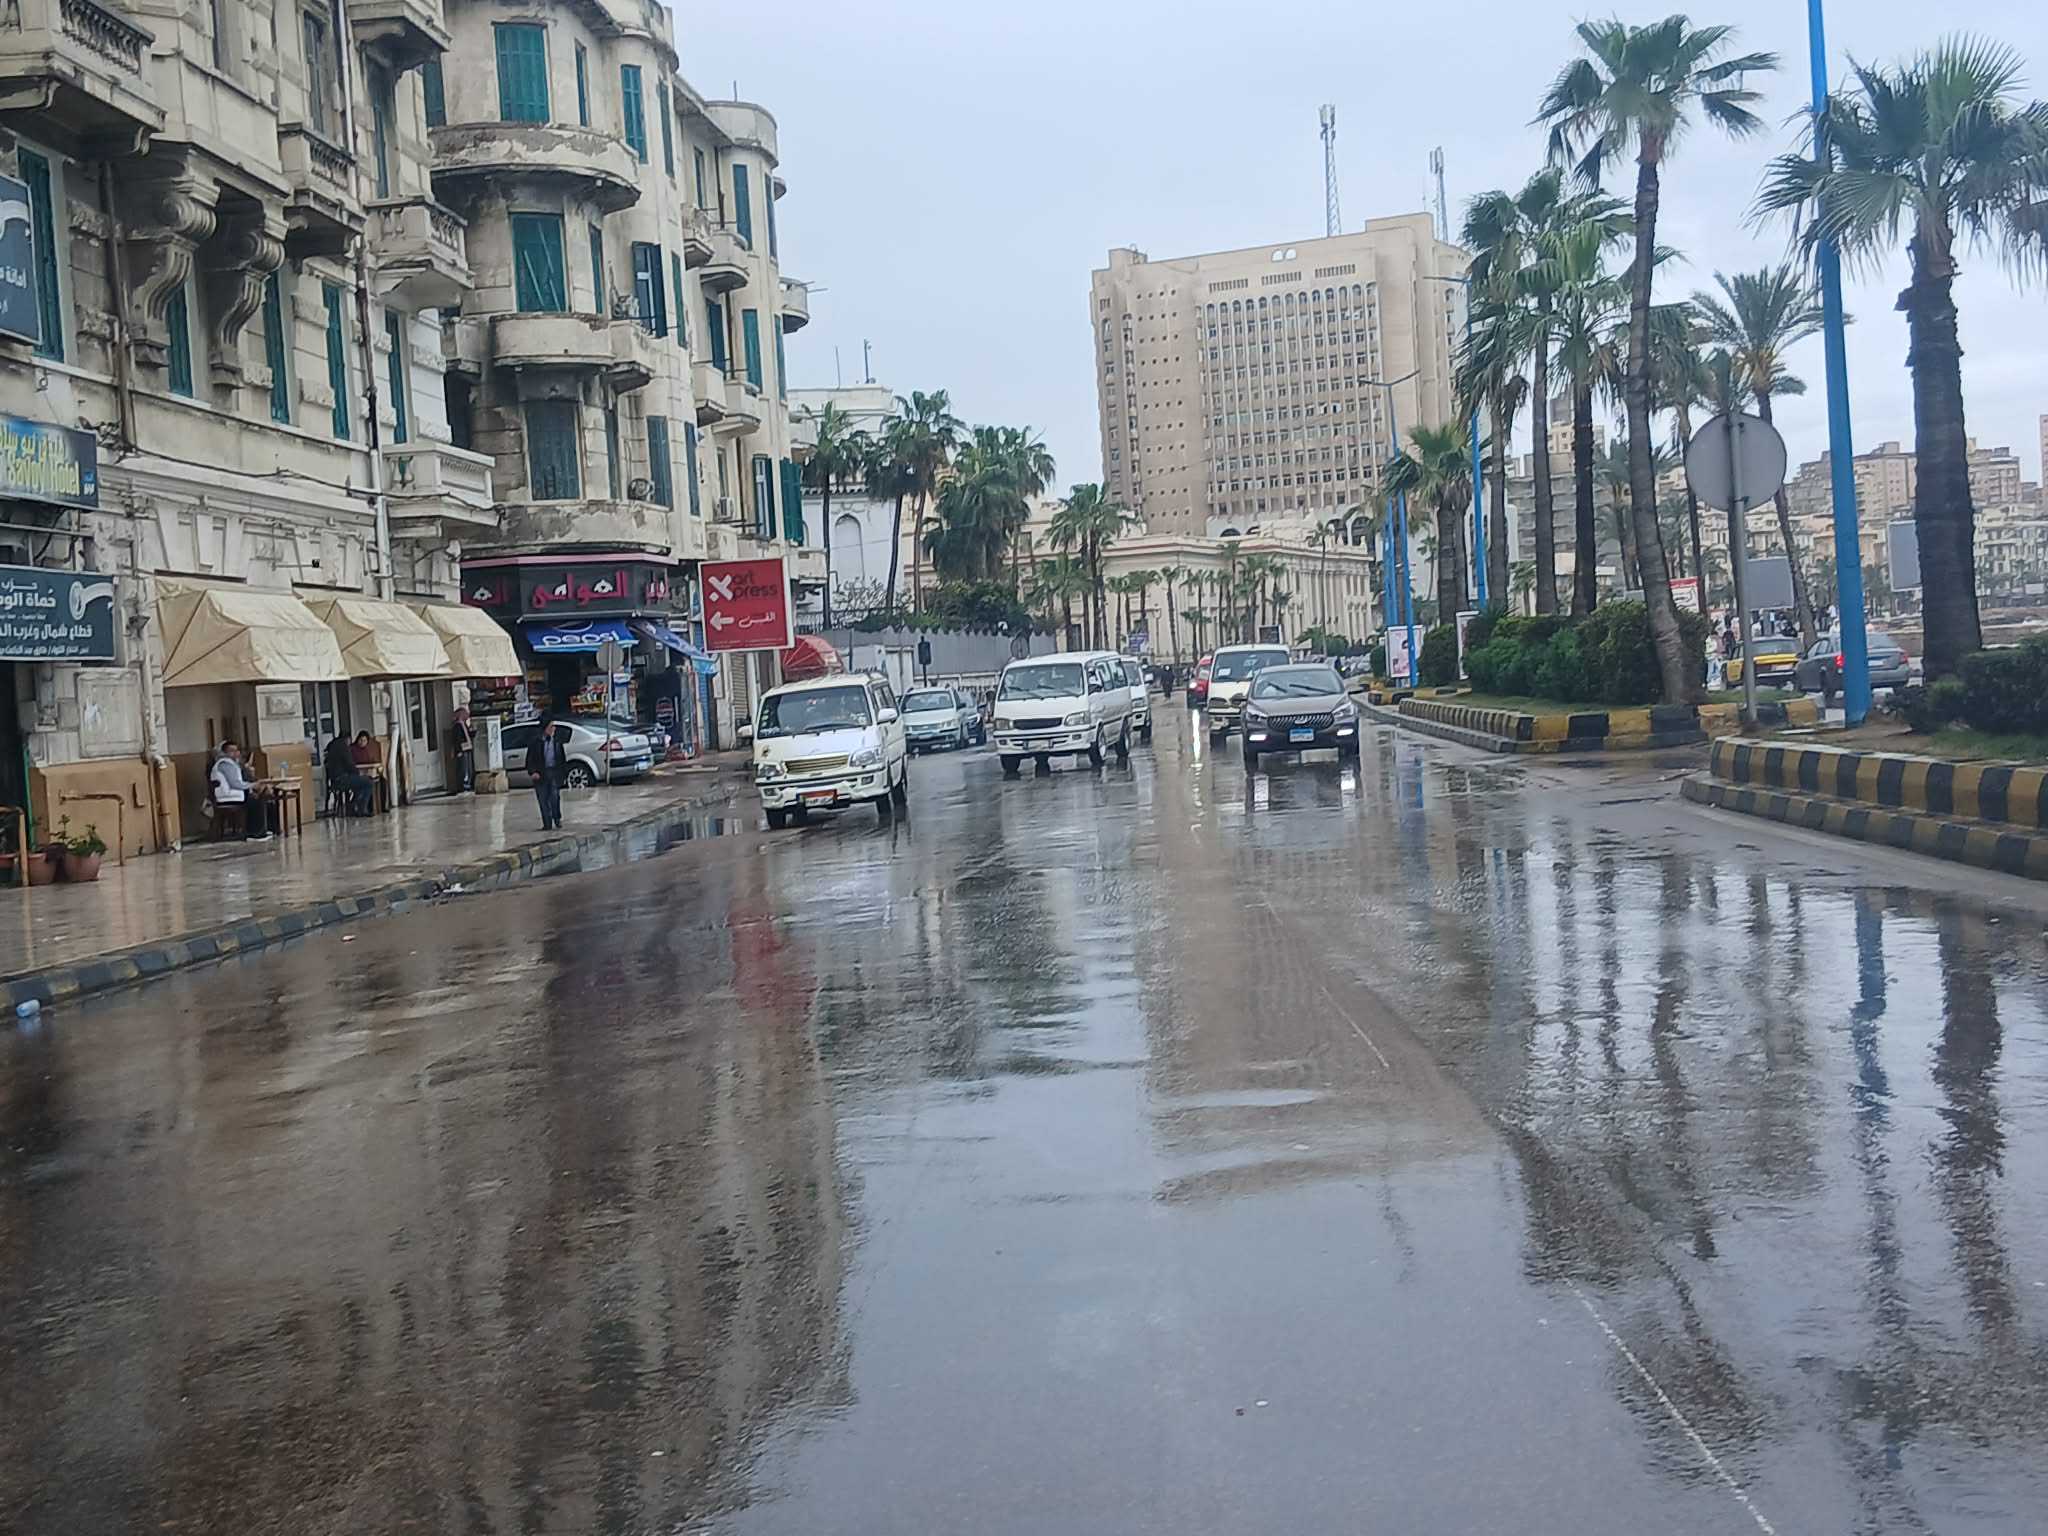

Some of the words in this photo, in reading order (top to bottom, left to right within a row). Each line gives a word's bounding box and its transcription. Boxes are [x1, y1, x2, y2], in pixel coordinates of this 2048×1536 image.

[50, 459, 80, 496] Hotel
[13, 624, 39, 640] وغرب
[41, 623, 68, 640] شمال
[69, 624, 93, 640] قطاع
[542, 630, 619, 646] pepsi
